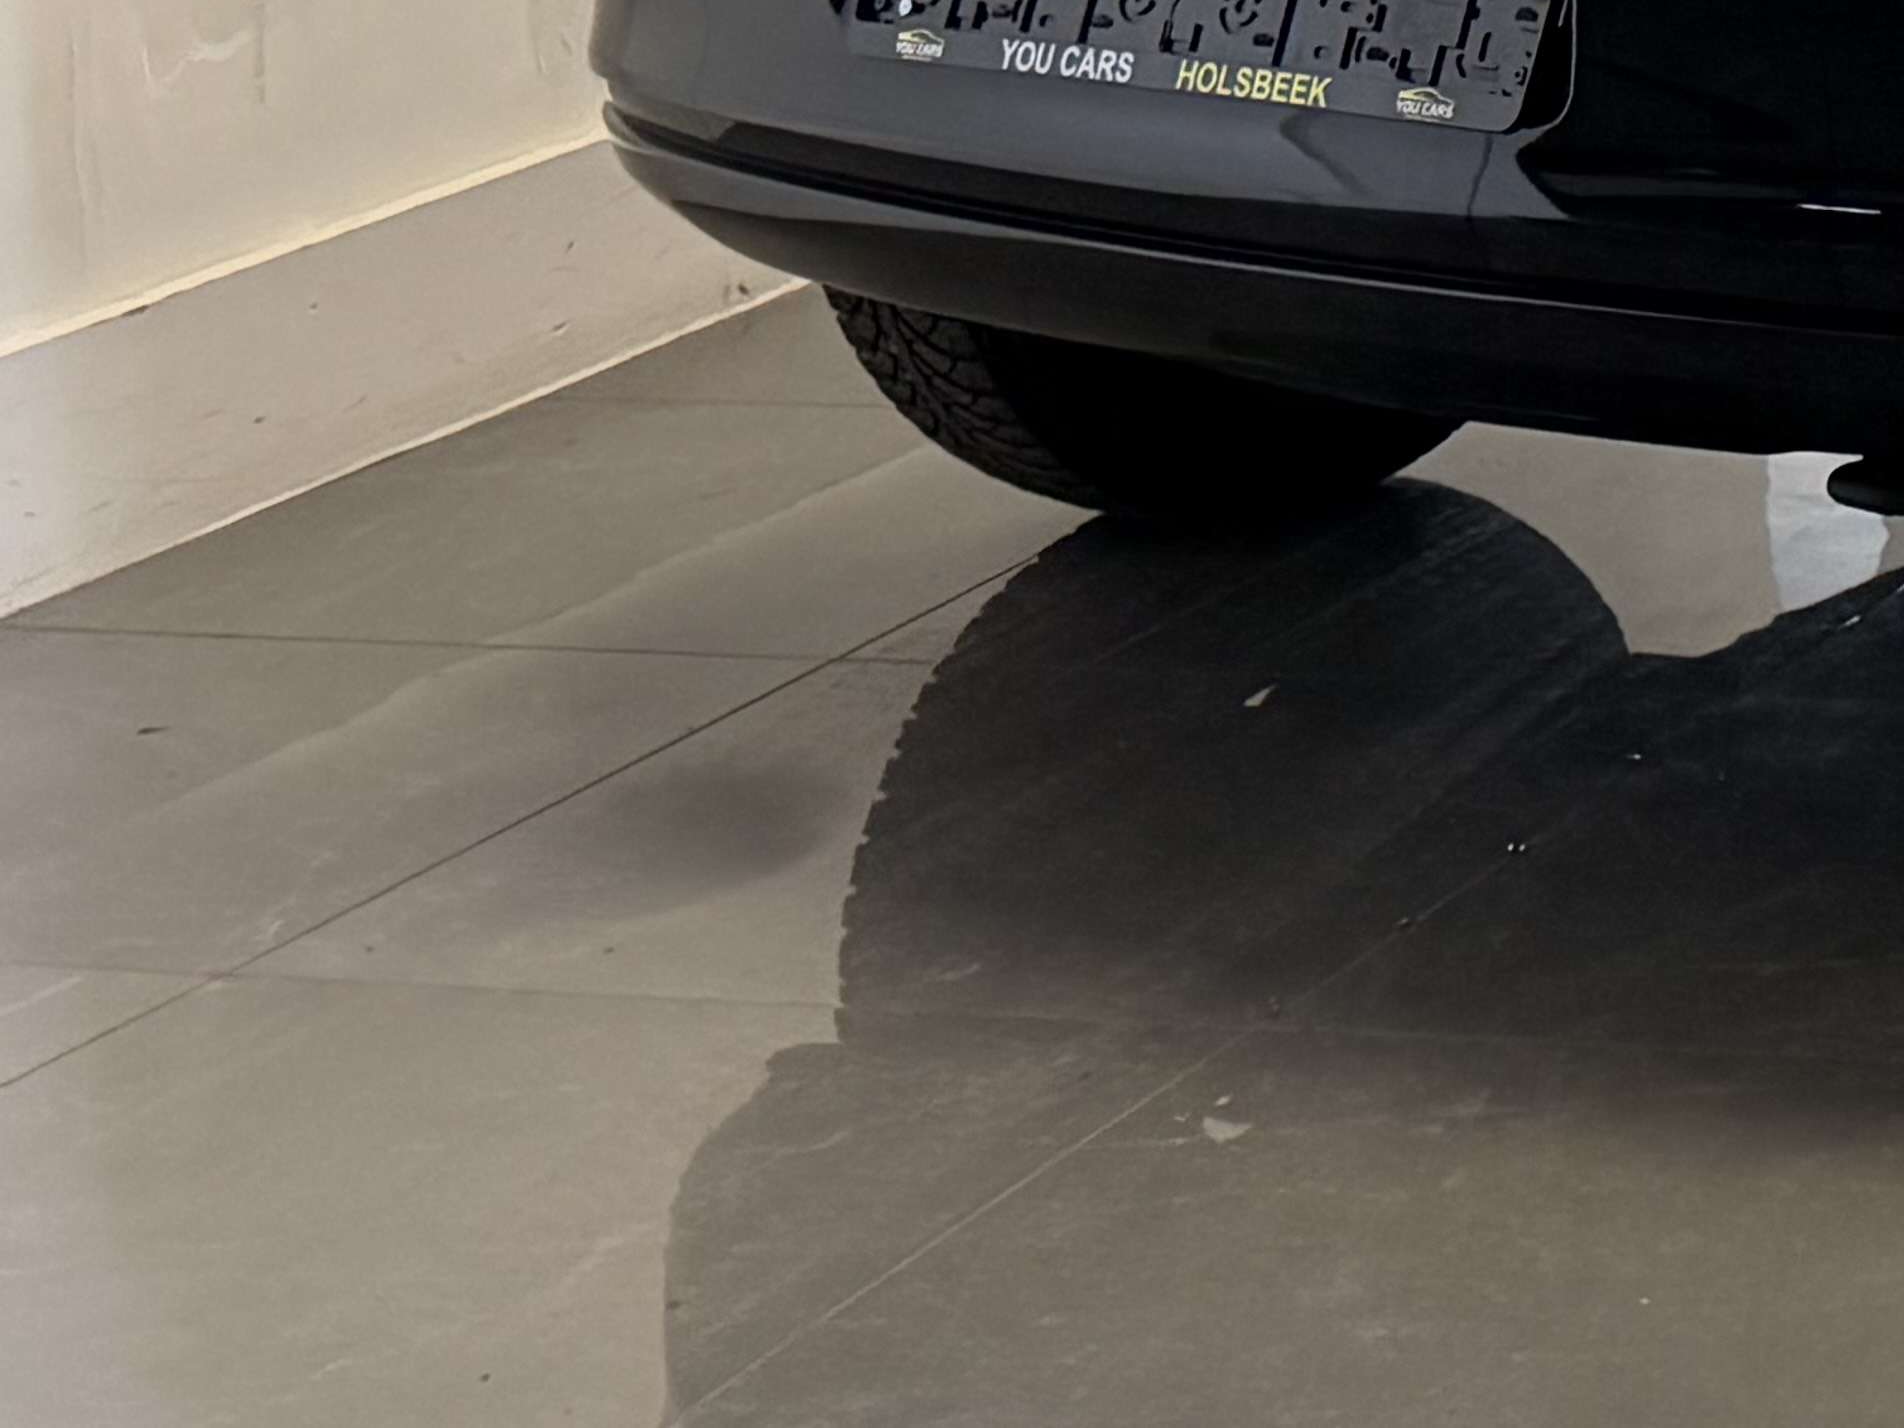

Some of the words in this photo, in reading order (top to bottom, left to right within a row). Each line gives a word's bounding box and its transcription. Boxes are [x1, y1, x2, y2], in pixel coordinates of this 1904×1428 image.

[1001, 38, 1056, 75] YOU
[1059, 46, 1136, 84] CARS
[1175, 59, 1333, 108] HOLSBEEK
